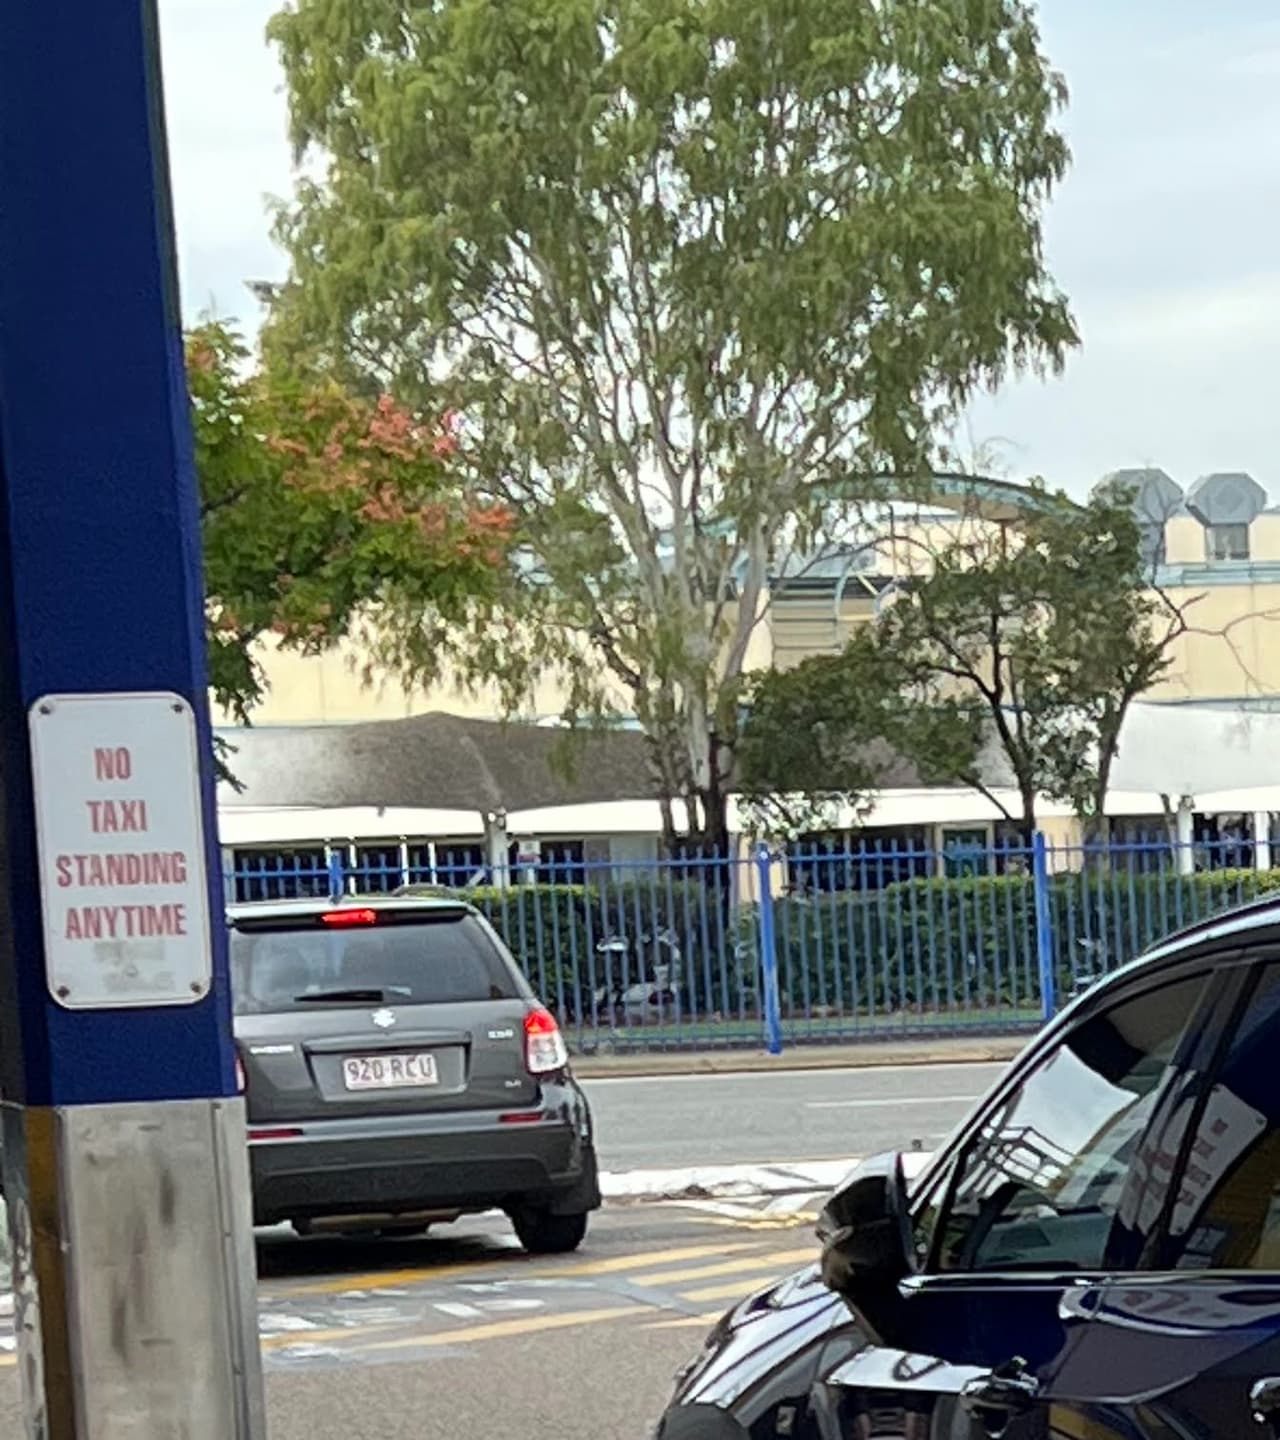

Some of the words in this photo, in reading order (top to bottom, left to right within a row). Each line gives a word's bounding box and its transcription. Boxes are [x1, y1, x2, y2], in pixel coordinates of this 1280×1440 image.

[94, 747, 131, 780] NO
[86, 800, 147, 832] TAXI
[55, 852, 187, 887] STANDING
[64, 904, 187, 939] ANYTIME
[390, 1055, 432, 1079] RCU
